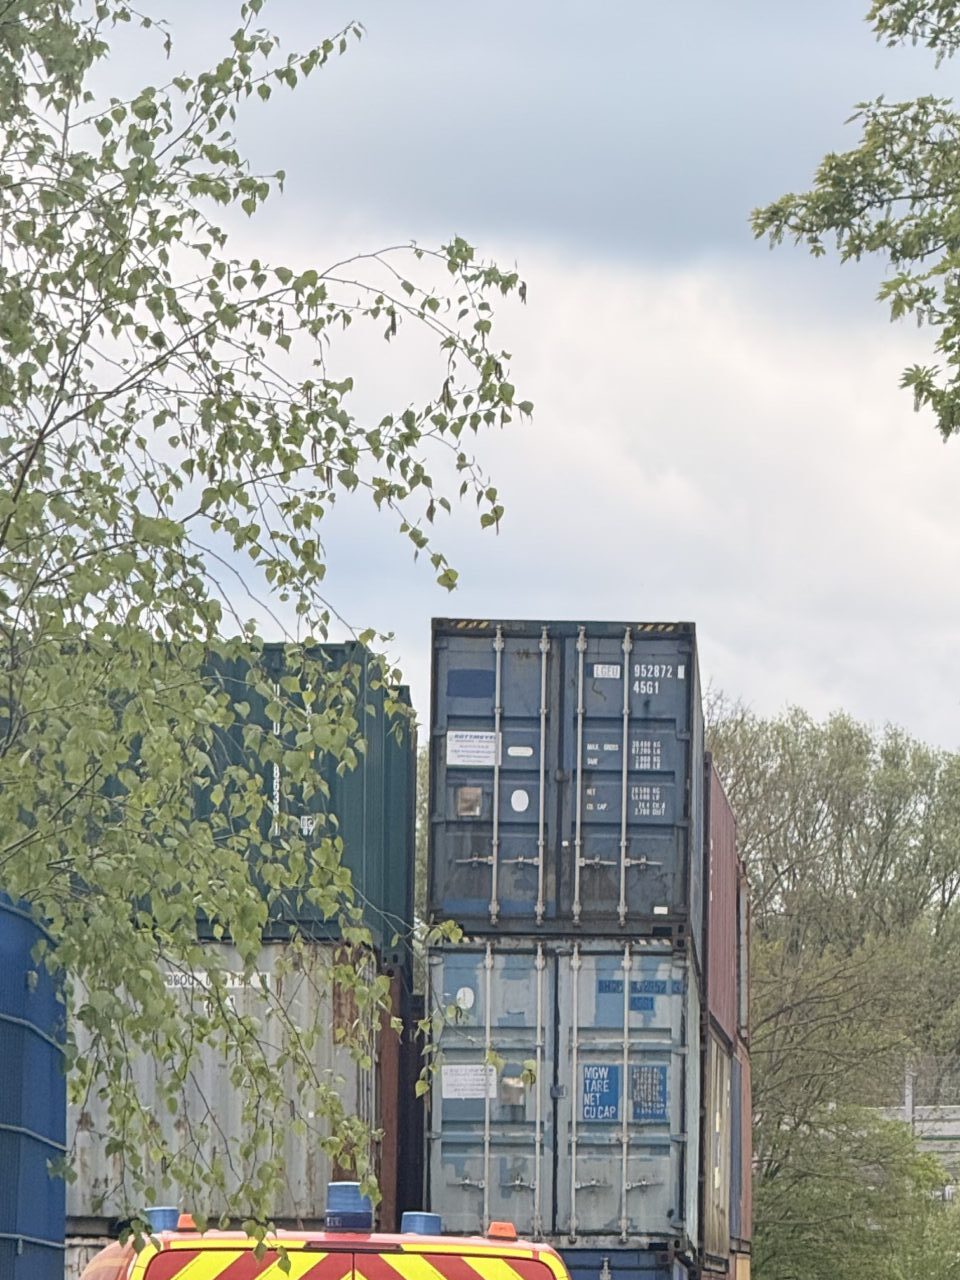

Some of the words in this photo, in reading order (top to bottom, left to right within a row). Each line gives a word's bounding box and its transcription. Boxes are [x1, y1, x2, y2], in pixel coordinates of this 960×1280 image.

[634, 664, 673, 678] 952872
[633, 681, 659, 694] 45G1
[584, 1067, 608, 1079] MGW
[584, 1080, 609, 1092] TARE
[584, 1093, 600, 1106] NET
[584, 1106, 595, 1119] CU
[597, 1106, 616, 1118] CAP
